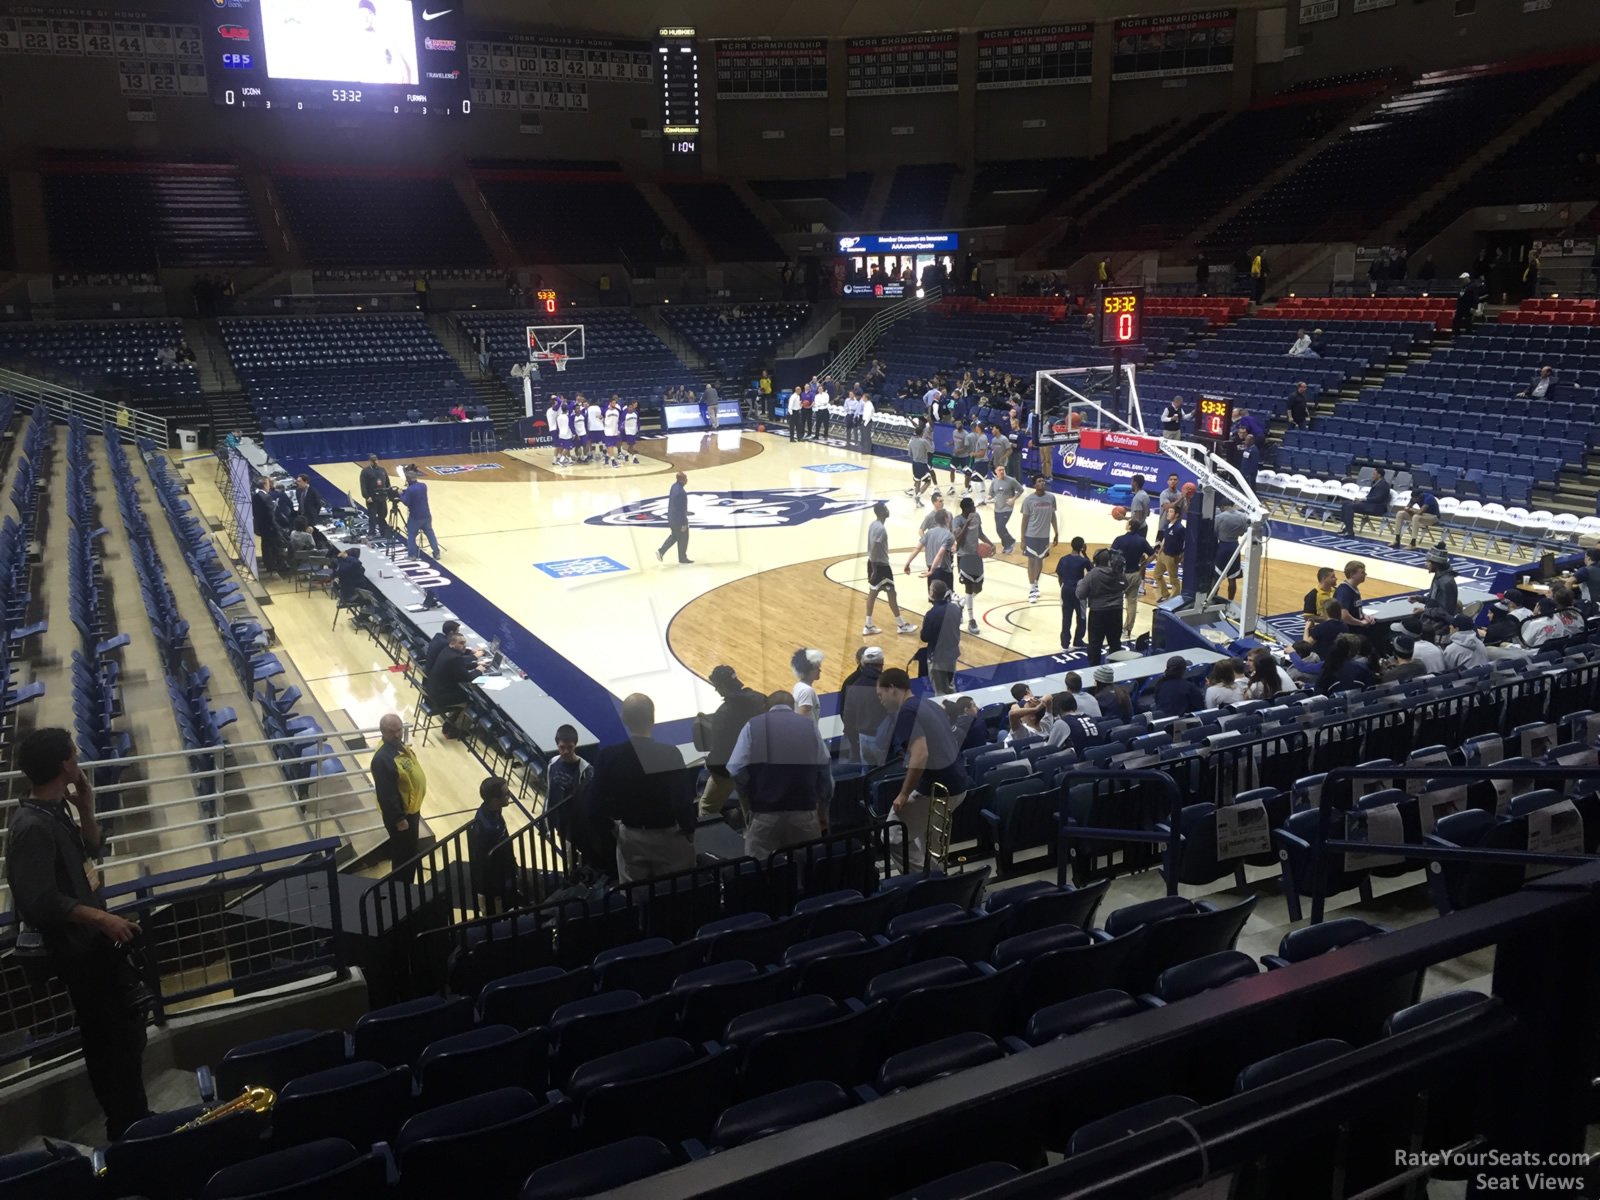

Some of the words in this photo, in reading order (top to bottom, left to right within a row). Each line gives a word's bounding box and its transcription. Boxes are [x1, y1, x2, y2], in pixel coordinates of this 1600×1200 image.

[1121, 20, 1147, 28] NCAA
[1152, 11, 1229, 25] CHAMPIONSHIP
[984, 31, 1009, 39] NCAA
[1014, 25, 1087, 37] CHAMPIONSHIP
[25, 34, 48, 48] 22
[57, 35, 79, 49] 25
[89, 37, 110, 50] 42
[119, 38, 141, 51] 44
[179, 41, 200, 54] 42
[751, 41, 821, 49] CHAMPIONSHIP
[881, 35, 952, 45] CHAMPIONSHIP
[223, 53, 250, 64] CBS
[472, 57, 487, 69] 52
[520, 59, 536, 71] 00
[545, 61, 559, 73] 13
[568, 62, 583, 74] 42
[125, 75, 143, 88] 13
[155, 76, 173, 89] 22
[225, 90, 235, 104] 0
[572, 95, 582, 106] 13
[462, 100, 471, 113] 0
[547, 299, 555, 312] 0
[1105, 296, 1136, 313] 53:32
[1120, 314, 1132, 339] 0
[1212, 417, 1220, 433] 0
[1076, 456, 1107, 470] Webster
